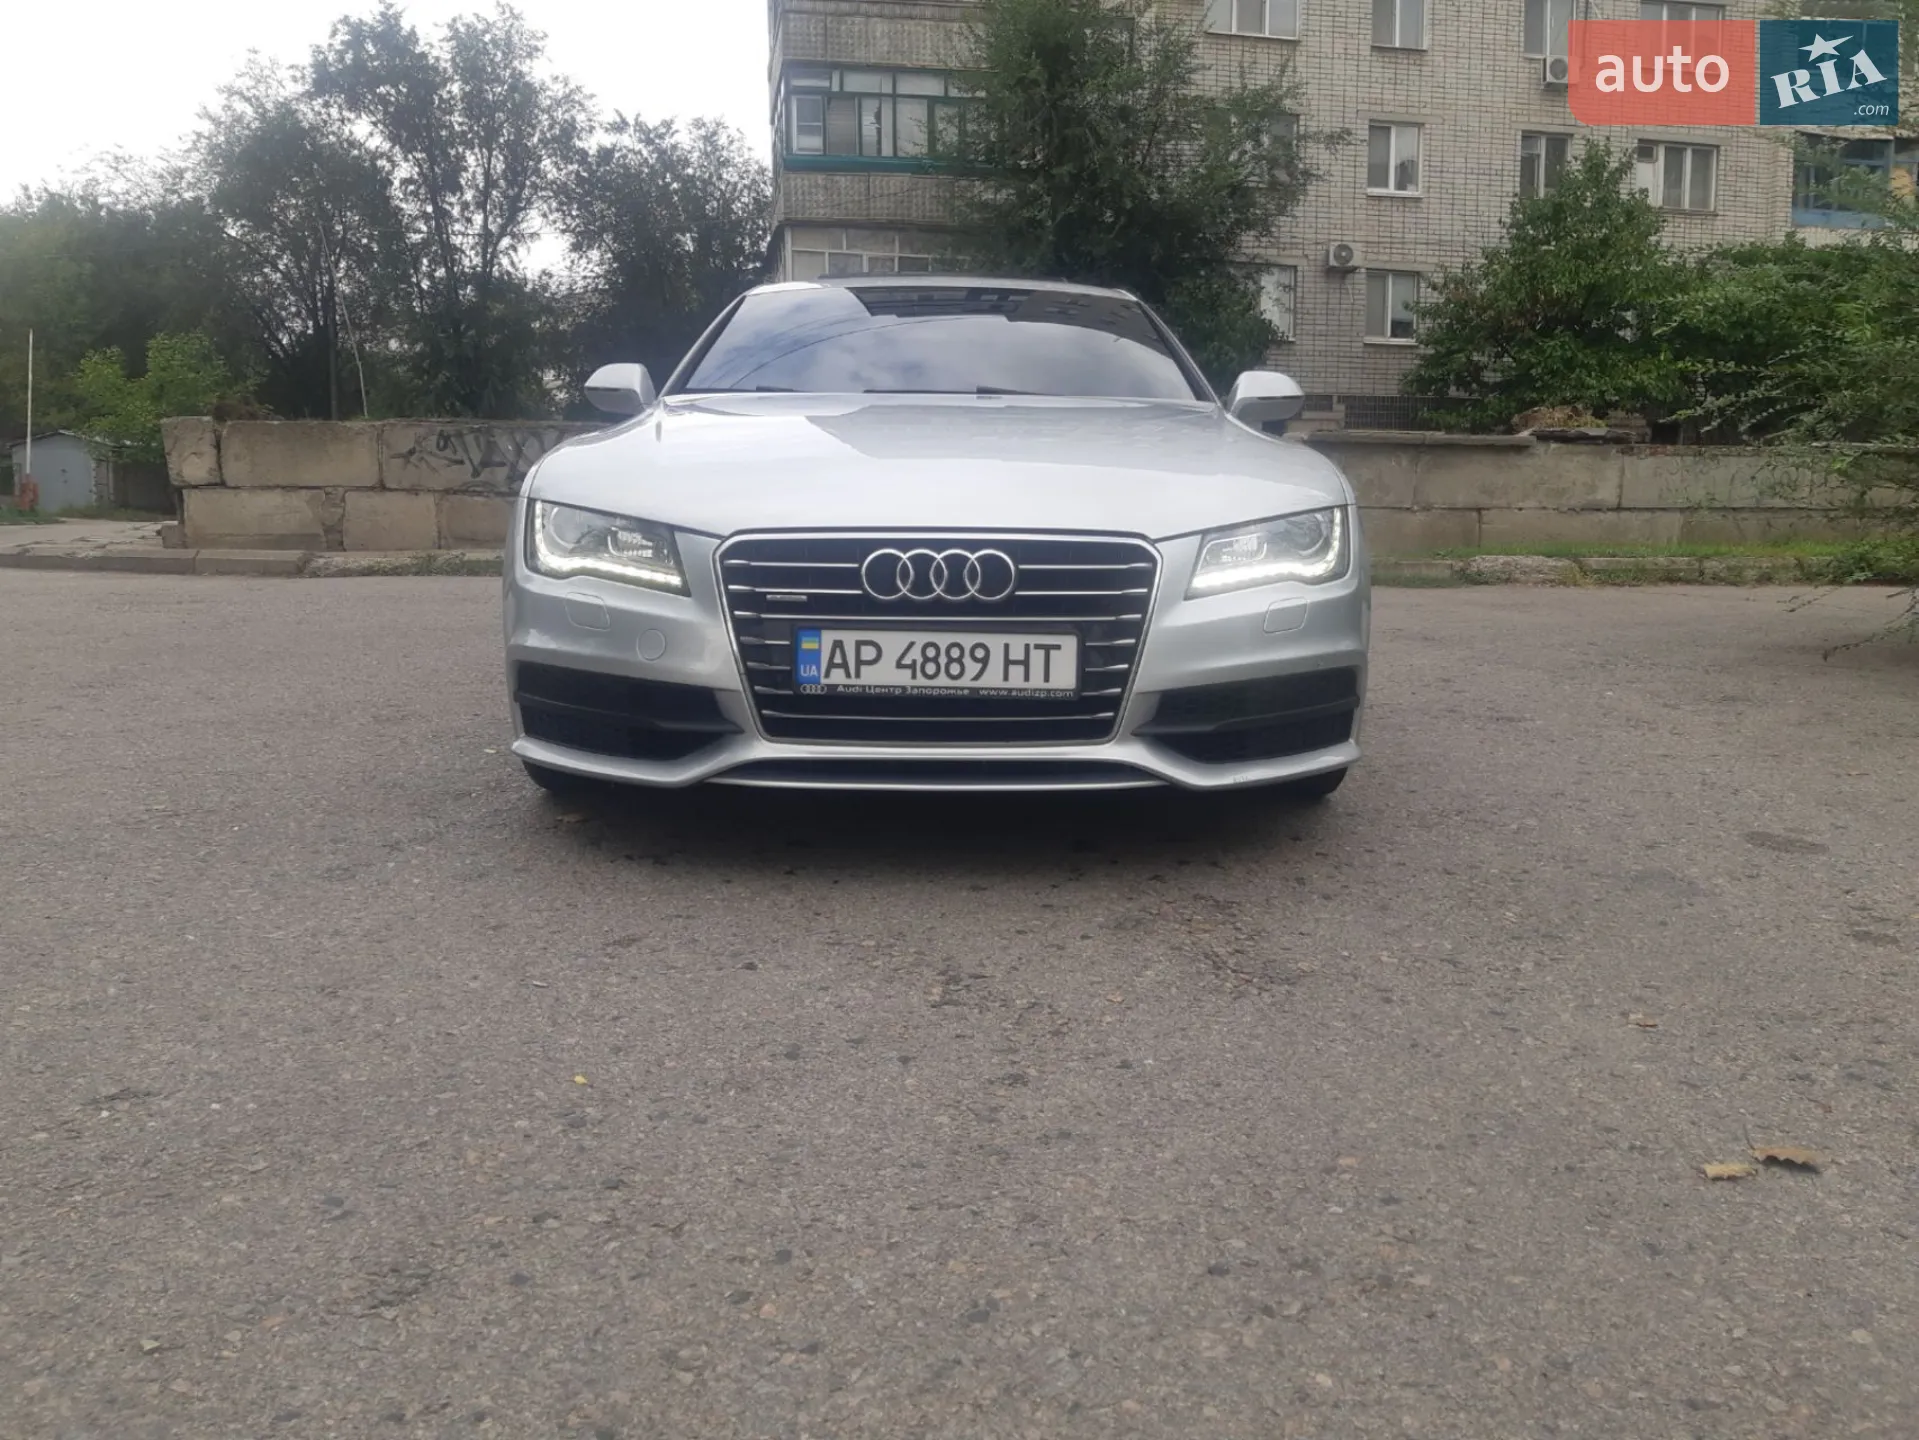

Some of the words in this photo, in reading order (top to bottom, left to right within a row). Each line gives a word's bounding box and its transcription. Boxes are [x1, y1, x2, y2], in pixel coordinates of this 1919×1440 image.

[823, 639, 883, 679] AP
[895, 640, 990, 682] 4889
[1002, 642, 1062, 683] HT
[800, 664, 818, 677] UA
[836, 684, 863, 694] Audi
[865, 684, 902, 696] Центр
